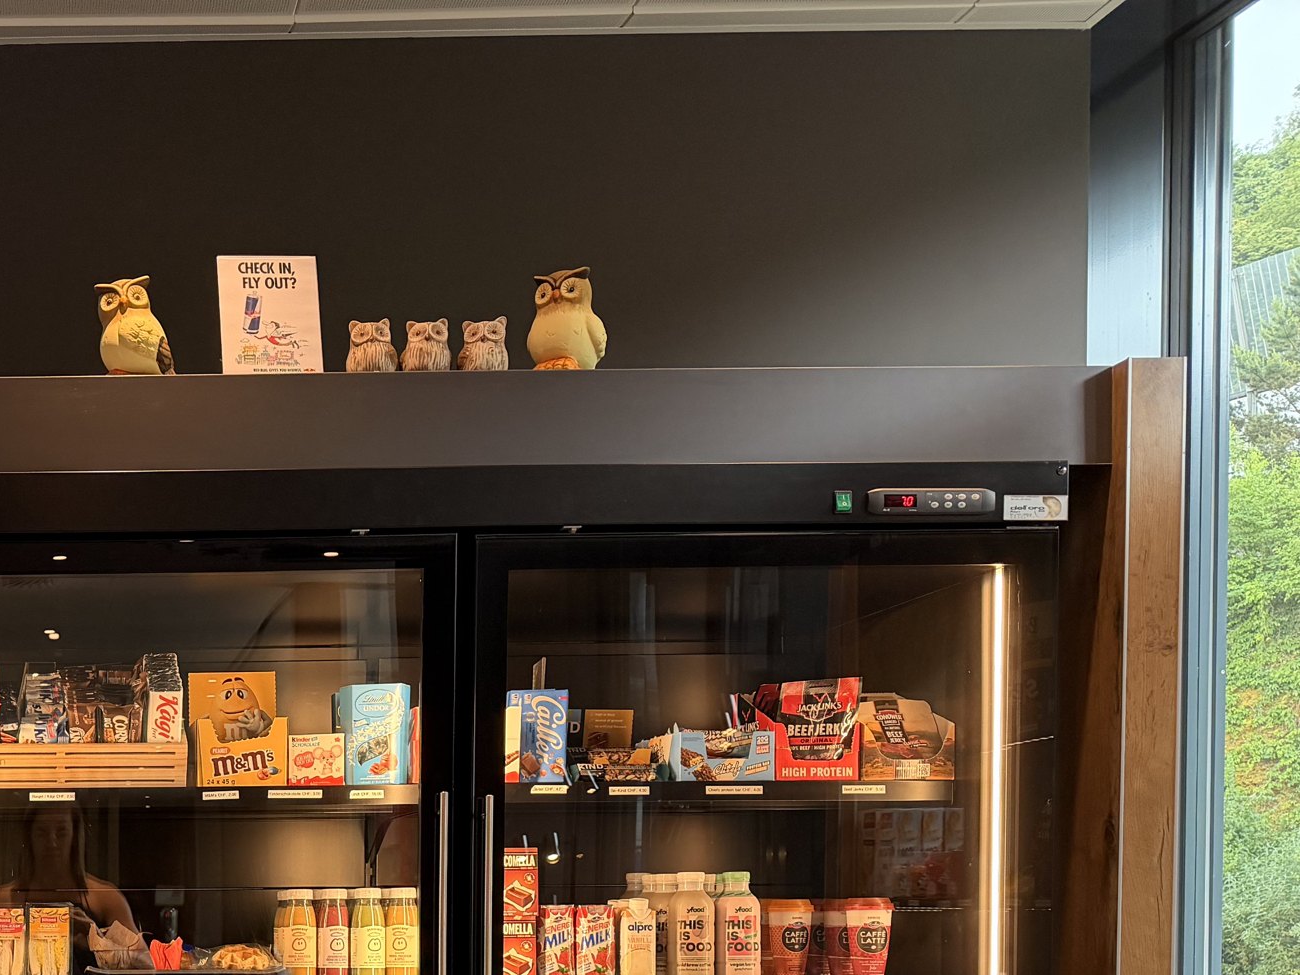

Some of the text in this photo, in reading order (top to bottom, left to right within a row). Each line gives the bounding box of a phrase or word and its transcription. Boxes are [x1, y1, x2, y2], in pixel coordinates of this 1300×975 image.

[237, 262, 295, 276] CHECK IN,
[242, 277, 297, 289] FLY OUT?
[156, 694, 178, 738] Kägi
[531, 695, 567, 765] Cailler
[787, 722, 847, 737] BEEF JERK
[782, 767, 853, 777] HIGH PROTEIN
[686, 906, 705, 914] yfood
[734, 906, 753, 914] yfood
[503, 923, 534, 935] OMELLA
[627, 922, 654, 934] alpro
[678, 920, 705, 930] THIS
[725, 920, 752, 930] THIS
[679, 931, 690, 941] IS
[727, 931, 739, 941] IS
[784, 930, 808, 938] CAFFÈ
[859, 929, 886, 938] CAFFÈ
[581, 929, 611, 951] MILK
[679, 942, 712, 952] FOOD
[727, 942, 759, 952] FOOD
